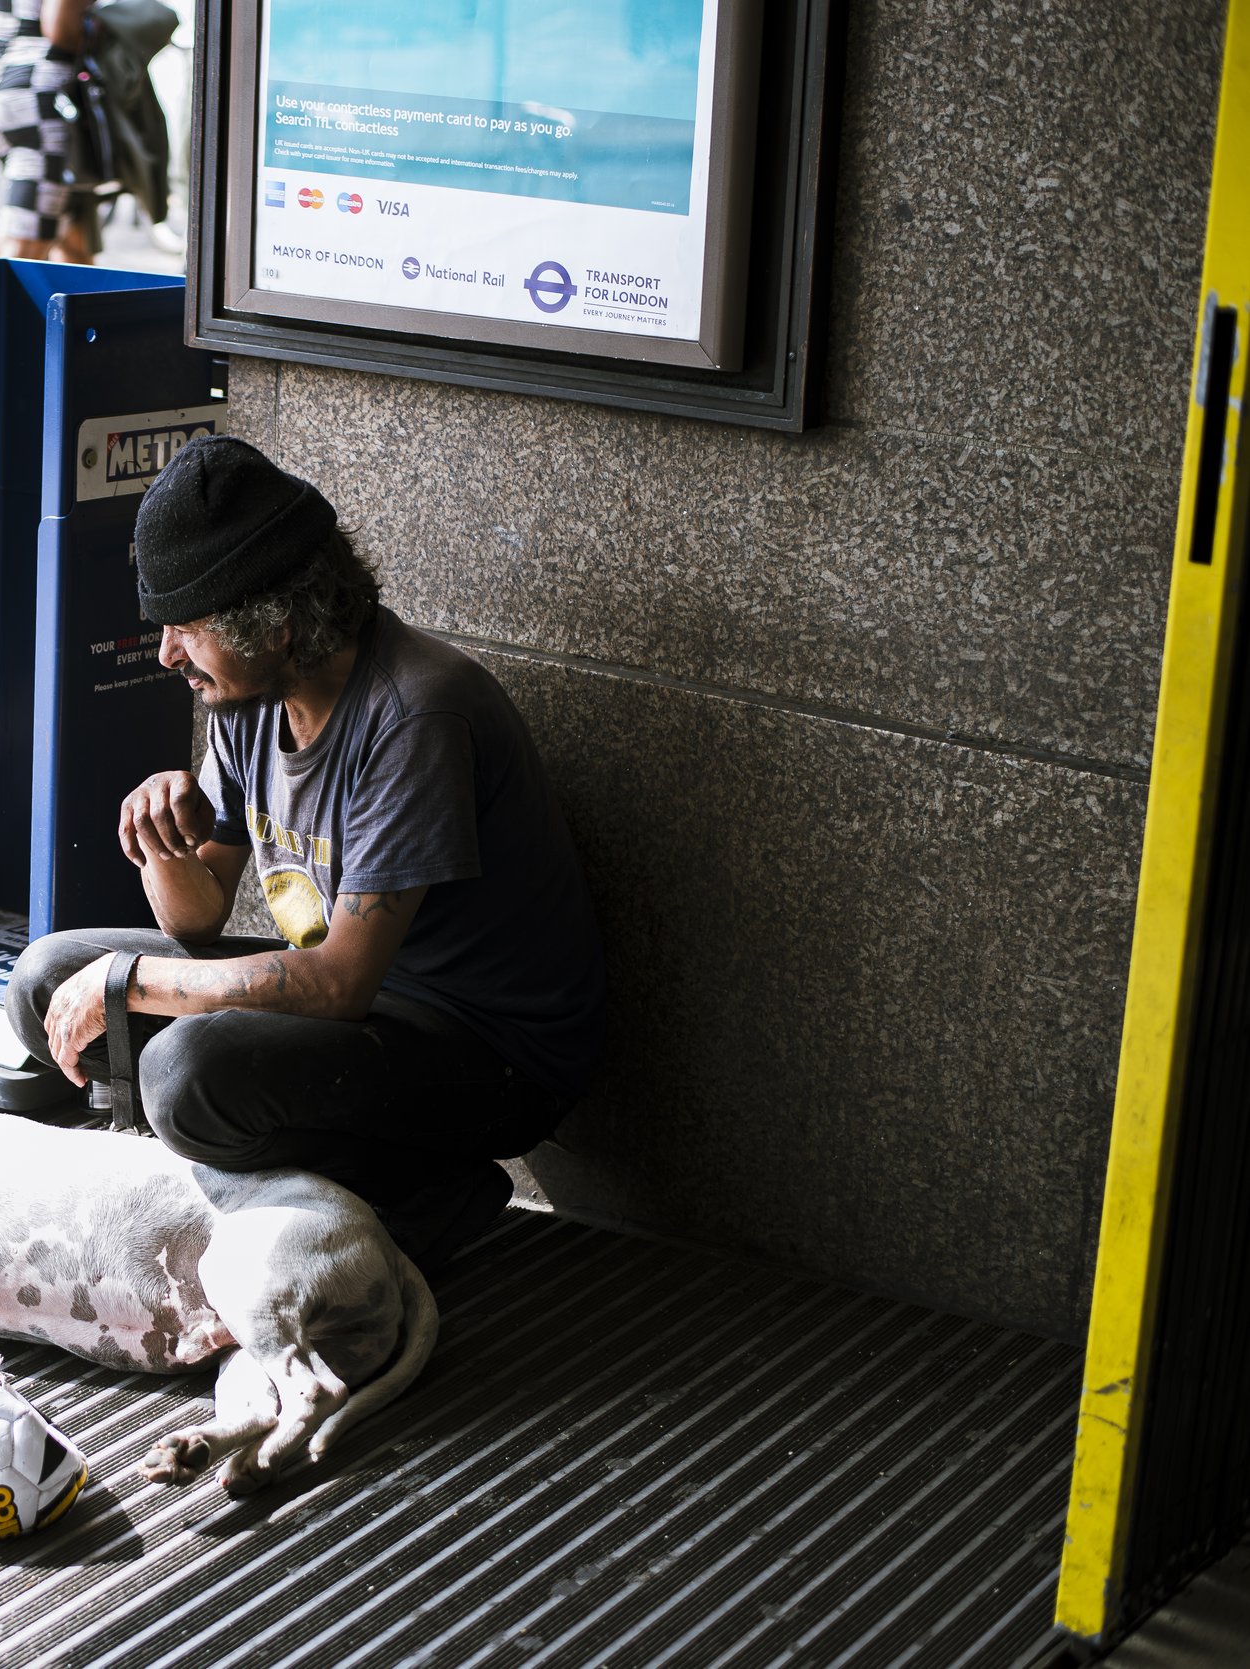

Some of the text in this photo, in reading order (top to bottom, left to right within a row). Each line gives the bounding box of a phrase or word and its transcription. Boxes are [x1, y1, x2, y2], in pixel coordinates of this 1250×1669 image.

[276, 95, 573, 139] Use your contactless payment card to pay as you go.
[276, 112, 399, 136] Search TfL contactless
[274, 148, 289, 156] Check
[290, 149, 301, 157] with
[302, 151, 313, 159] your
[314, 152, 325, 160] card
[350, 156, 364, 164] more
[300, 142, 313, 150] cards
[349, 147, 370, 156] Non-UK
[371, 150, 385, 158] cards
[386, 152, 396, 160] may
[415, 155, 440, 164] accepted
[440, 157, 450, 165] and
[451, 159, 484, 169] international
[484, 162, 515, 172] transaction
[515, 165, 549, 177] fees/charges
[550, 170, 562, 178] may
[562, 171, 579, 180] apply.
[376, 199, 411, 218] VISA
[272, 244, 384, 270] MAYOR OF LONDON
[425, 263, 505, 287] National Rail
[585, 269, 662, 290] TRANSPORT
[584, 286, 669, 309] FOR LONDON
[583, 308, 667, 327] EVERY JOURNEY MATTERS
[90, 640, 115, 655] YOUR
[117, 651, 143, 666] EVERY
[94, 680, 113, 692] Please
[114, 678, 129, 689] keep
[129, 676, 144, 687] your
[144, 673, 155, 683] city
